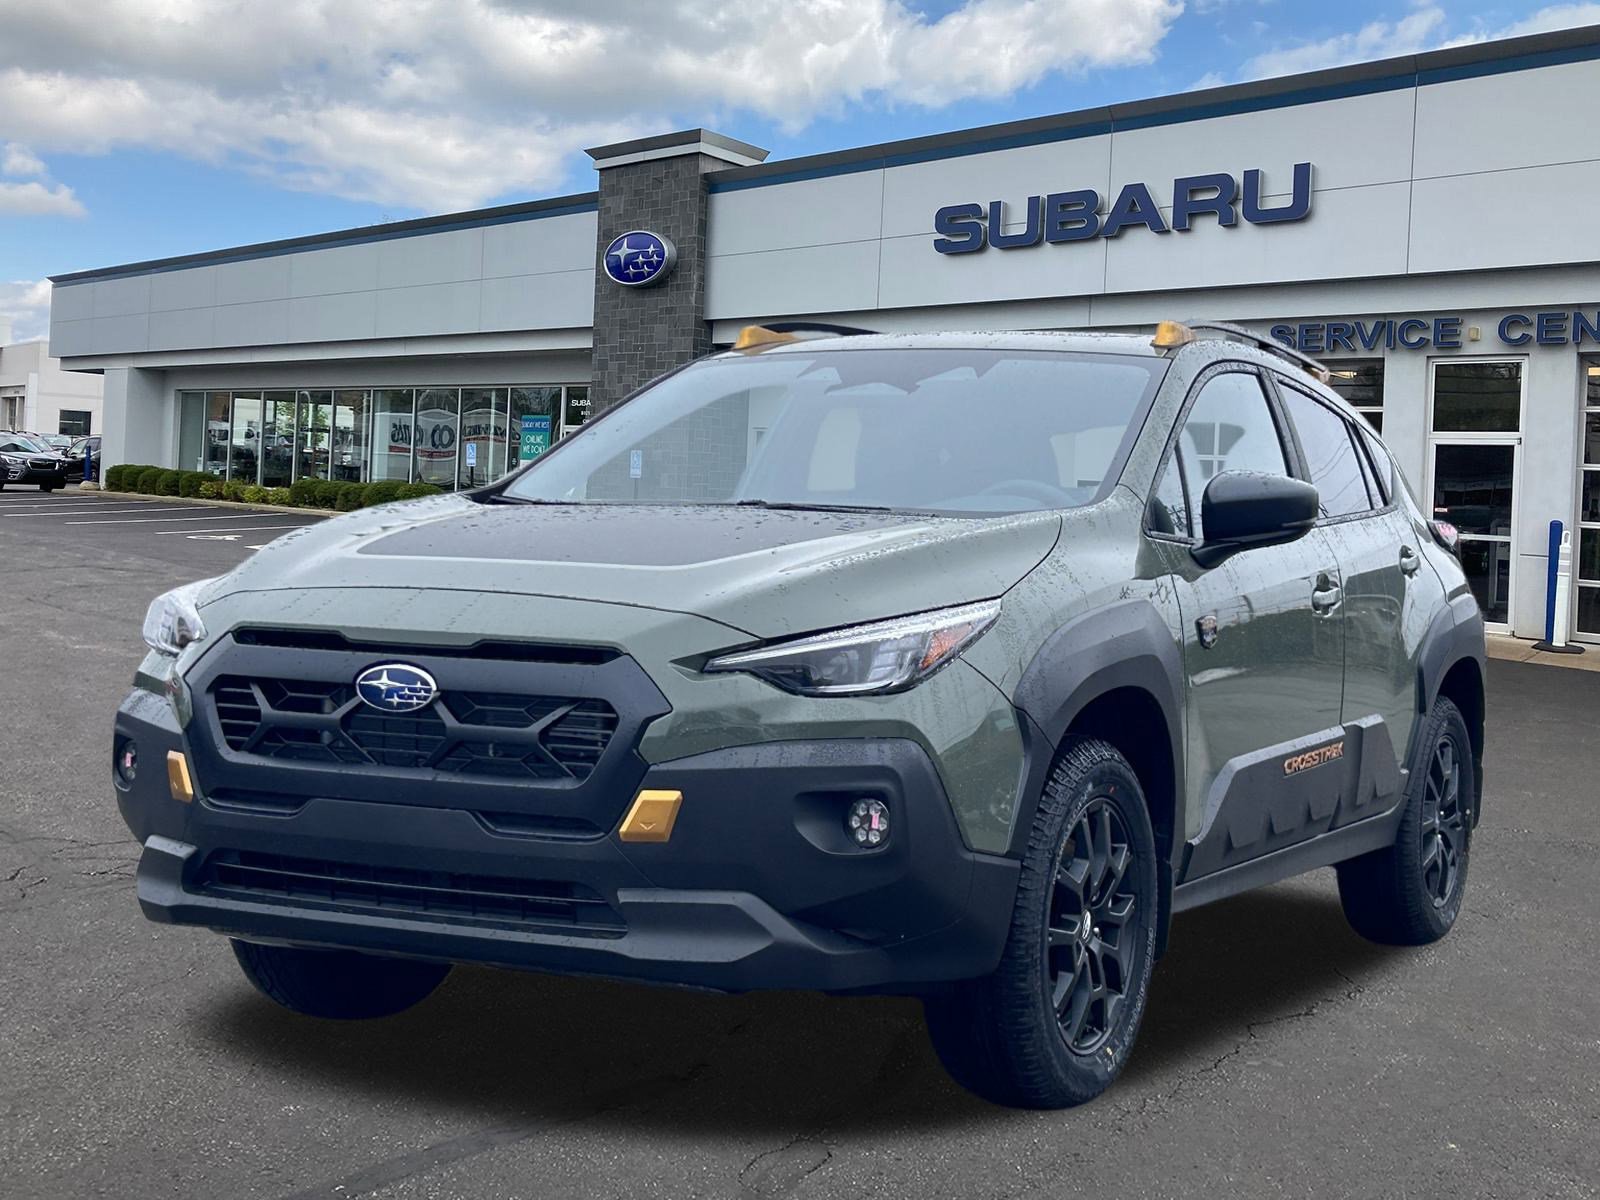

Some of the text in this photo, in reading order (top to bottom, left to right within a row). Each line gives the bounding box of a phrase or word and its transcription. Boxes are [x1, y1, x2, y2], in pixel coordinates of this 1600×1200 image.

[933, 162, 1314, 256] SUBARU
[1269, 317, 1464, 351] SERVICE
[1283, 741, 1344, 775] CROSSTREK
